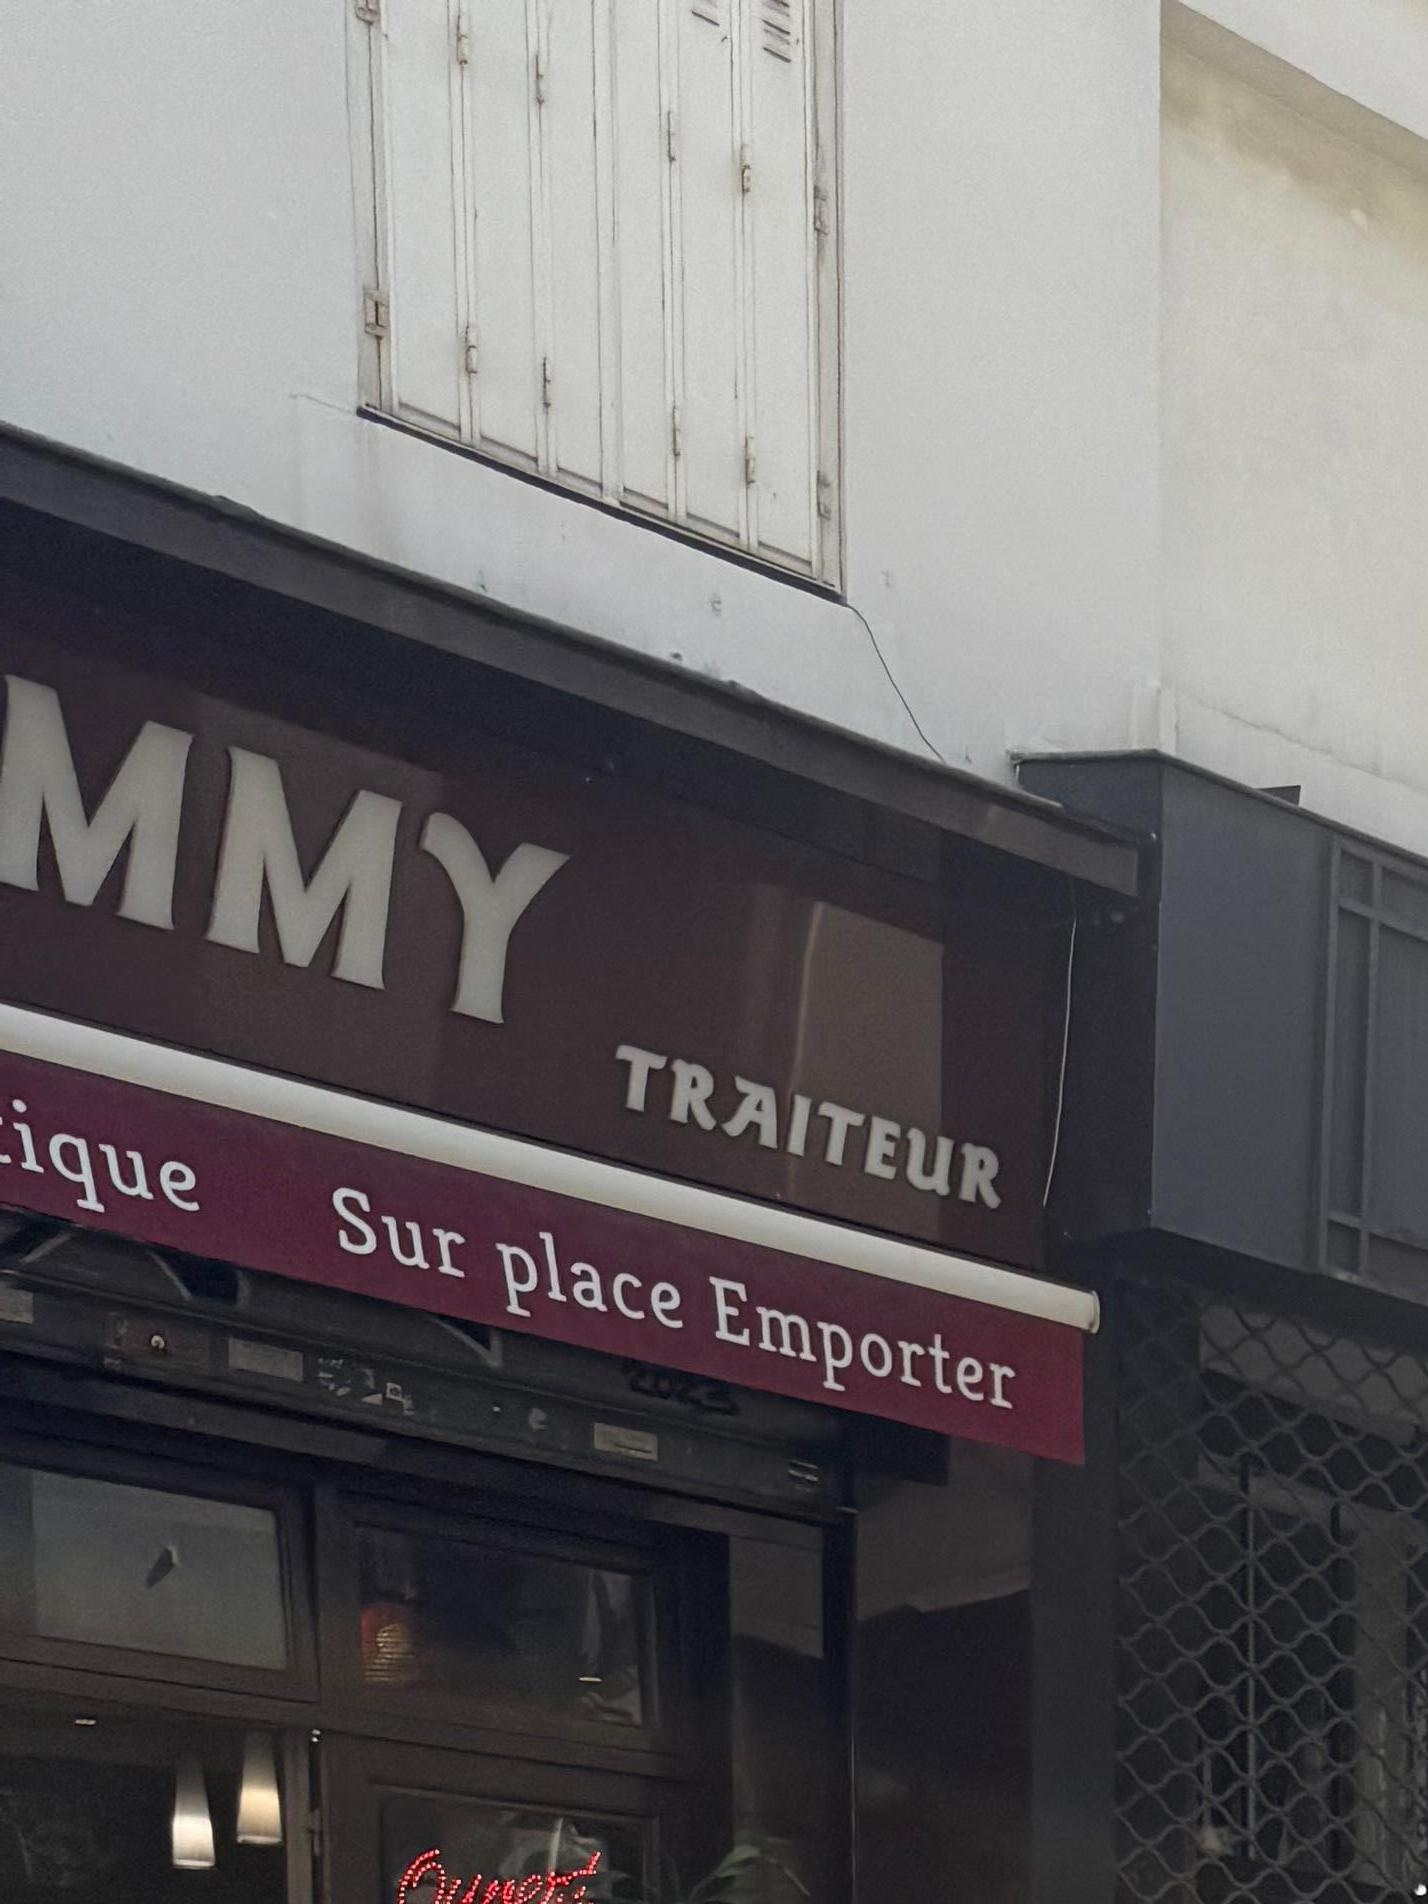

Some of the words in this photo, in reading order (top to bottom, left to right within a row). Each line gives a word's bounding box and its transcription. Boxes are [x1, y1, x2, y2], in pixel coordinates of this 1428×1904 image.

[614, 1042, 1002, 1209] TRAITEUR
[332, 1187, 466, 1280] Sur
[495, 1232, 684, 1330] place
[708, 1275, 1017, 1411] Emporter
